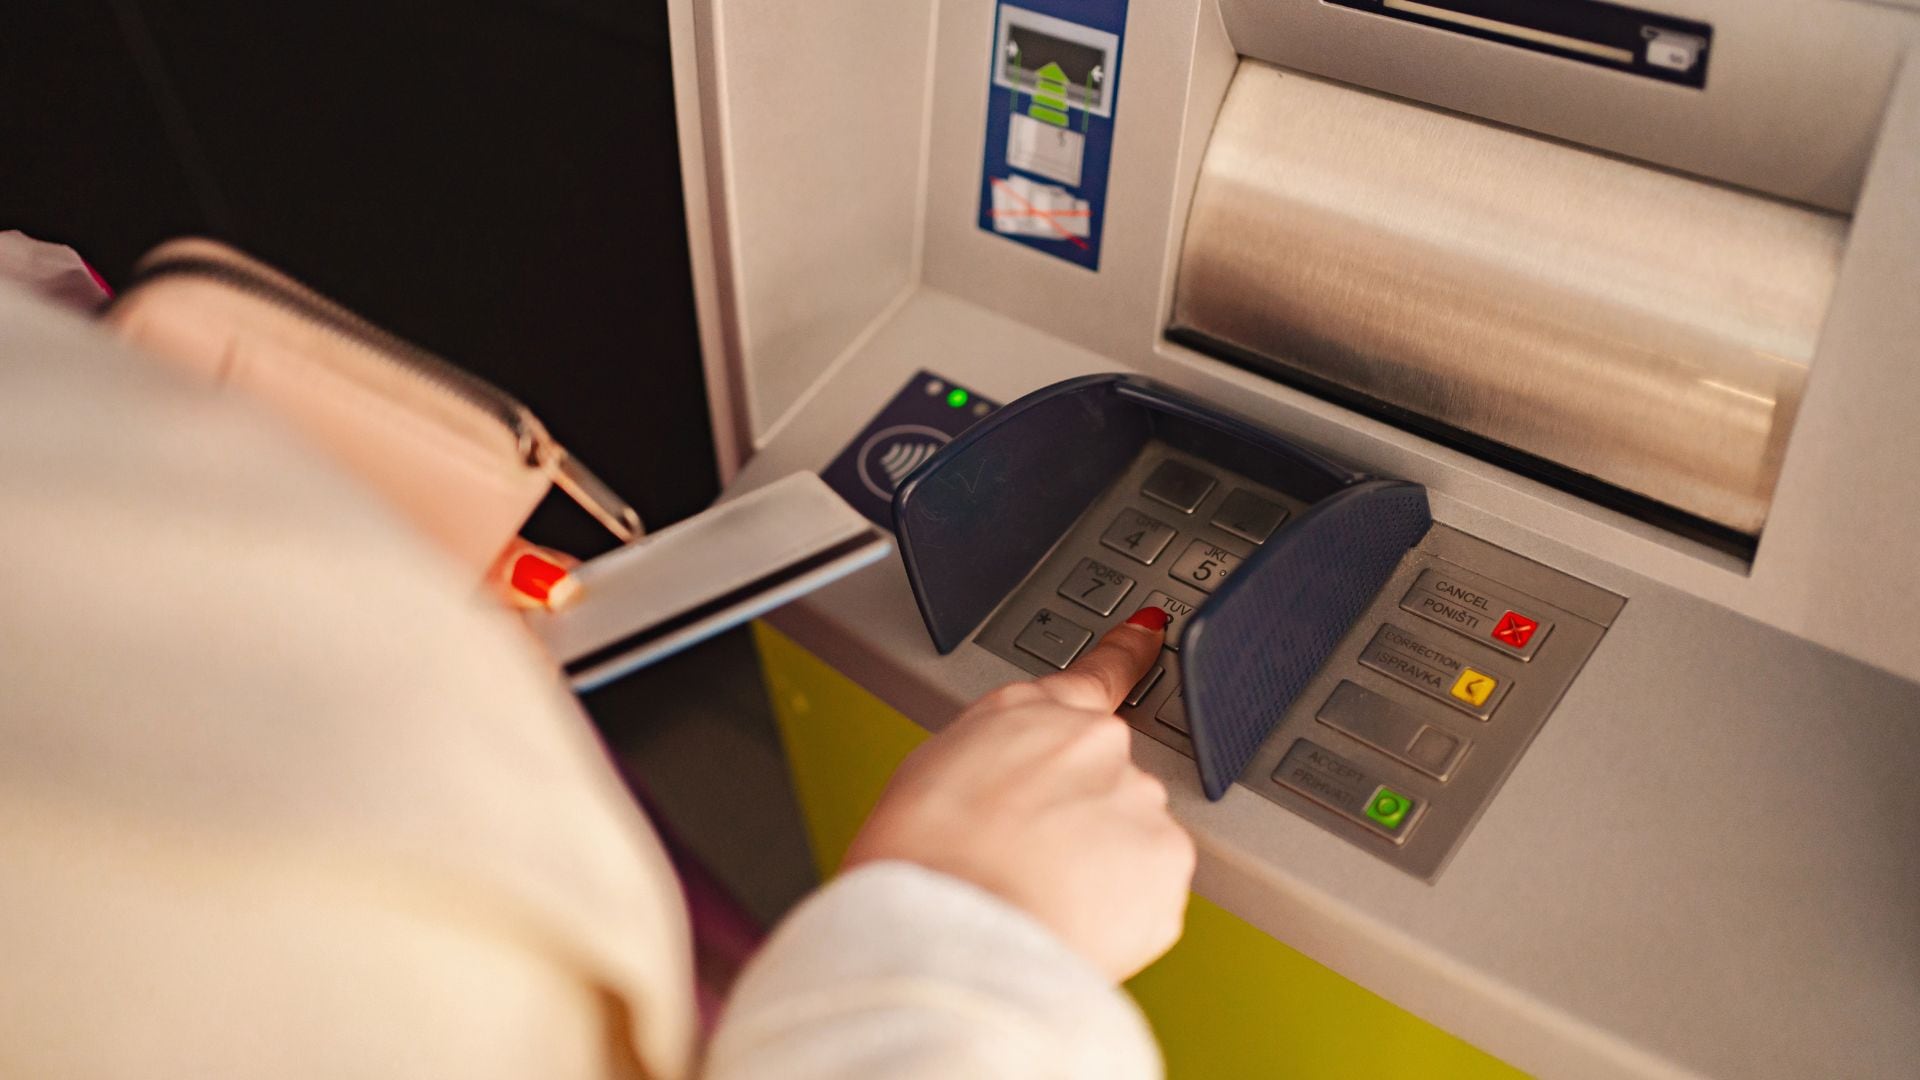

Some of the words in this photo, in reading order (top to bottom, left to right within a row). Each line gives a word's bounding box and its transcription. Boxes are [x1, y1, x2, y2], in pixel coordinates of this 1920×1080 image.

[1125, 531, 1146, 549] 4
[1204, 547, 1228, 564] JKL
[1193, 560, 1217, 581] 5
[1081, 578, 1105, 598] 7
[1435, 581, 1489, 611] CANCEL
[1163, 597, 1193, 617] TUV
[1423, 598, 1480, 629] PONIŠTI
[1384, 631, 1462, 671] CORRECTION
[1376, 651, 1442, 688] ISPRAVKA
[1309, 751, 1366, 781] ACCEPT
